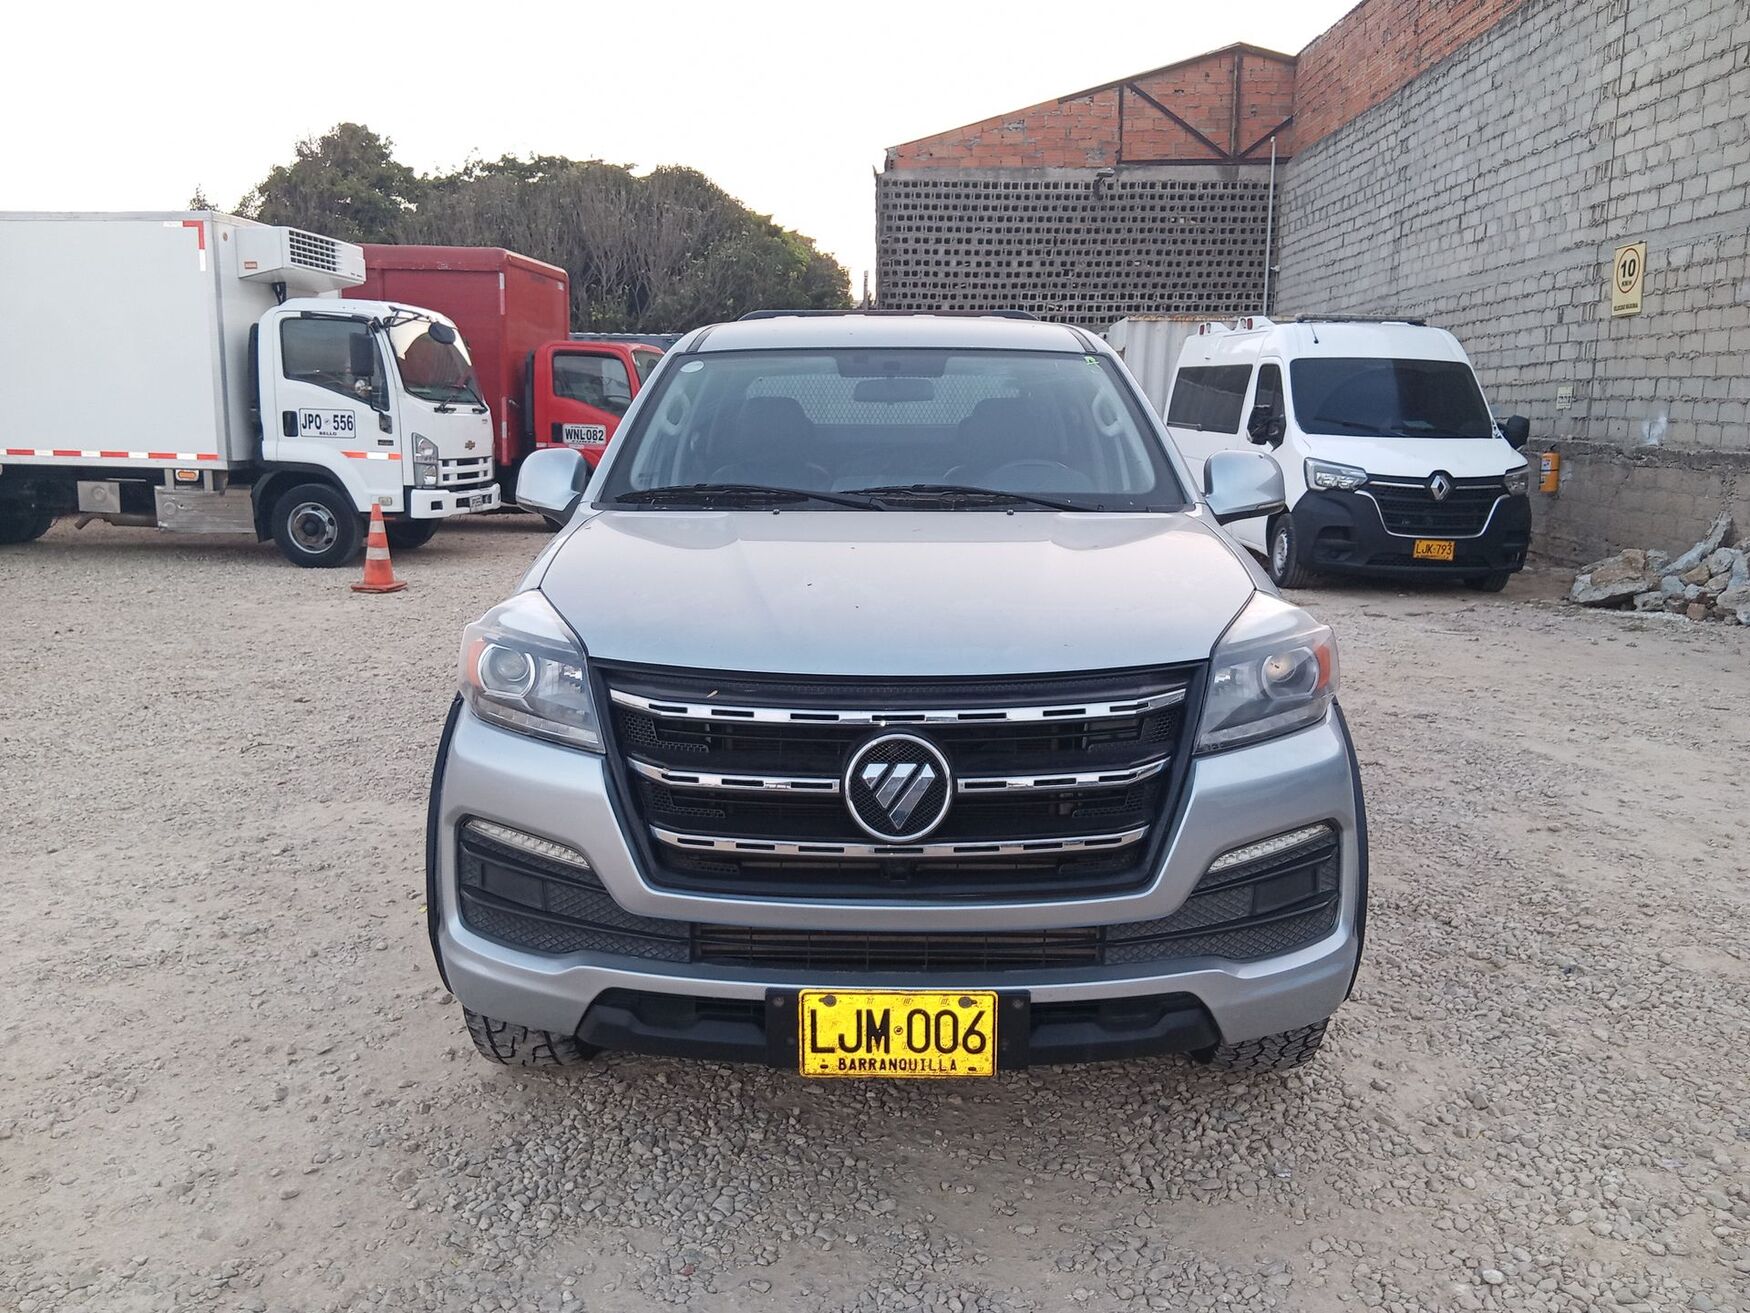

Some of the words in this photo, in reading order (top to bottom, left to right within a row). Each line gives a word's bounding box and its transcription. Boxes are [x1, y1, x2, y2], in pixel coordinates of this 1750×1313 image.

[1620, 258, 1636, 278] 10
[302, 413, 322, 430] JPO
[333, 414, 354, 431] 556
[838, 1058, 958, 1071] BARRANQUILLA
